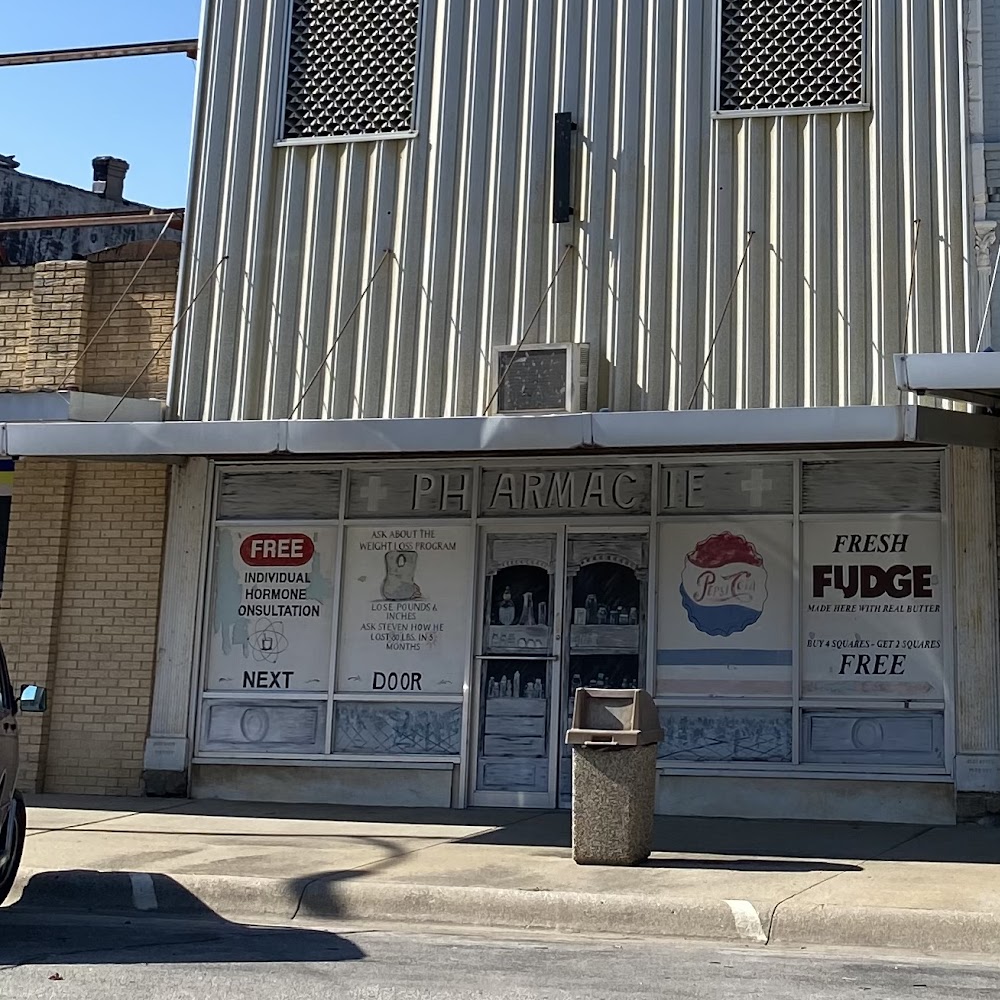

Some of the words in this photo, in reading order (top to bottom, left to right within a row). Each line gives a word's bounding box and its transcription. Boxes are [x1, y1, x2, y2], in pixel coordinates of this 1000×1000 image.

[372, 530, 387, 538] ASK
[390, 529, 417, 538] ABOUT
[420, 528, 435, 538] THE
[250, 539, 305, 558] FREE
[359, 541, 393, 551] WEIGHT
[415, 541, 457, 550] PROGRAM
[833, 534, 909, 553] FRESH
[244, 572, 311, 583] INDIVIDUAL
[813, 565, 932, 599] FUDGE
[245, 588, 306, 600] HORMONE
[371, 603, 393, 611] LOSE
[396, 603, 431, 611] POUNDS
[808, 604, 831, 612] MADE
[833, 604, 856, 612] HERE
[859, 604, 881, 612] WITH
[882, 604, 904, 612] REAL
[906, 604, 940, 612] BUTTER
[386, 612, 416, 620] INCHES
[378, 623, 408, 631] STEVEN
[411, 623, 431, 631] HOW
[433, 623, 444, 631] HE
[370, 633, 389, 641] LOST
[418, 633, 427, 641] IN
[386, 643, 420, 651] MONTHS
[807, 639, 825, 648] BUY
[831, 639, 870, 649] SQUARES
[877, 639, 894, 648] GET
[902, 639, 941, 649] SQUARES
[839, 654, 906, 675] FREE
[243, 671, 294, 688] NEXT
[372, 671, 422, 690] DOOR
